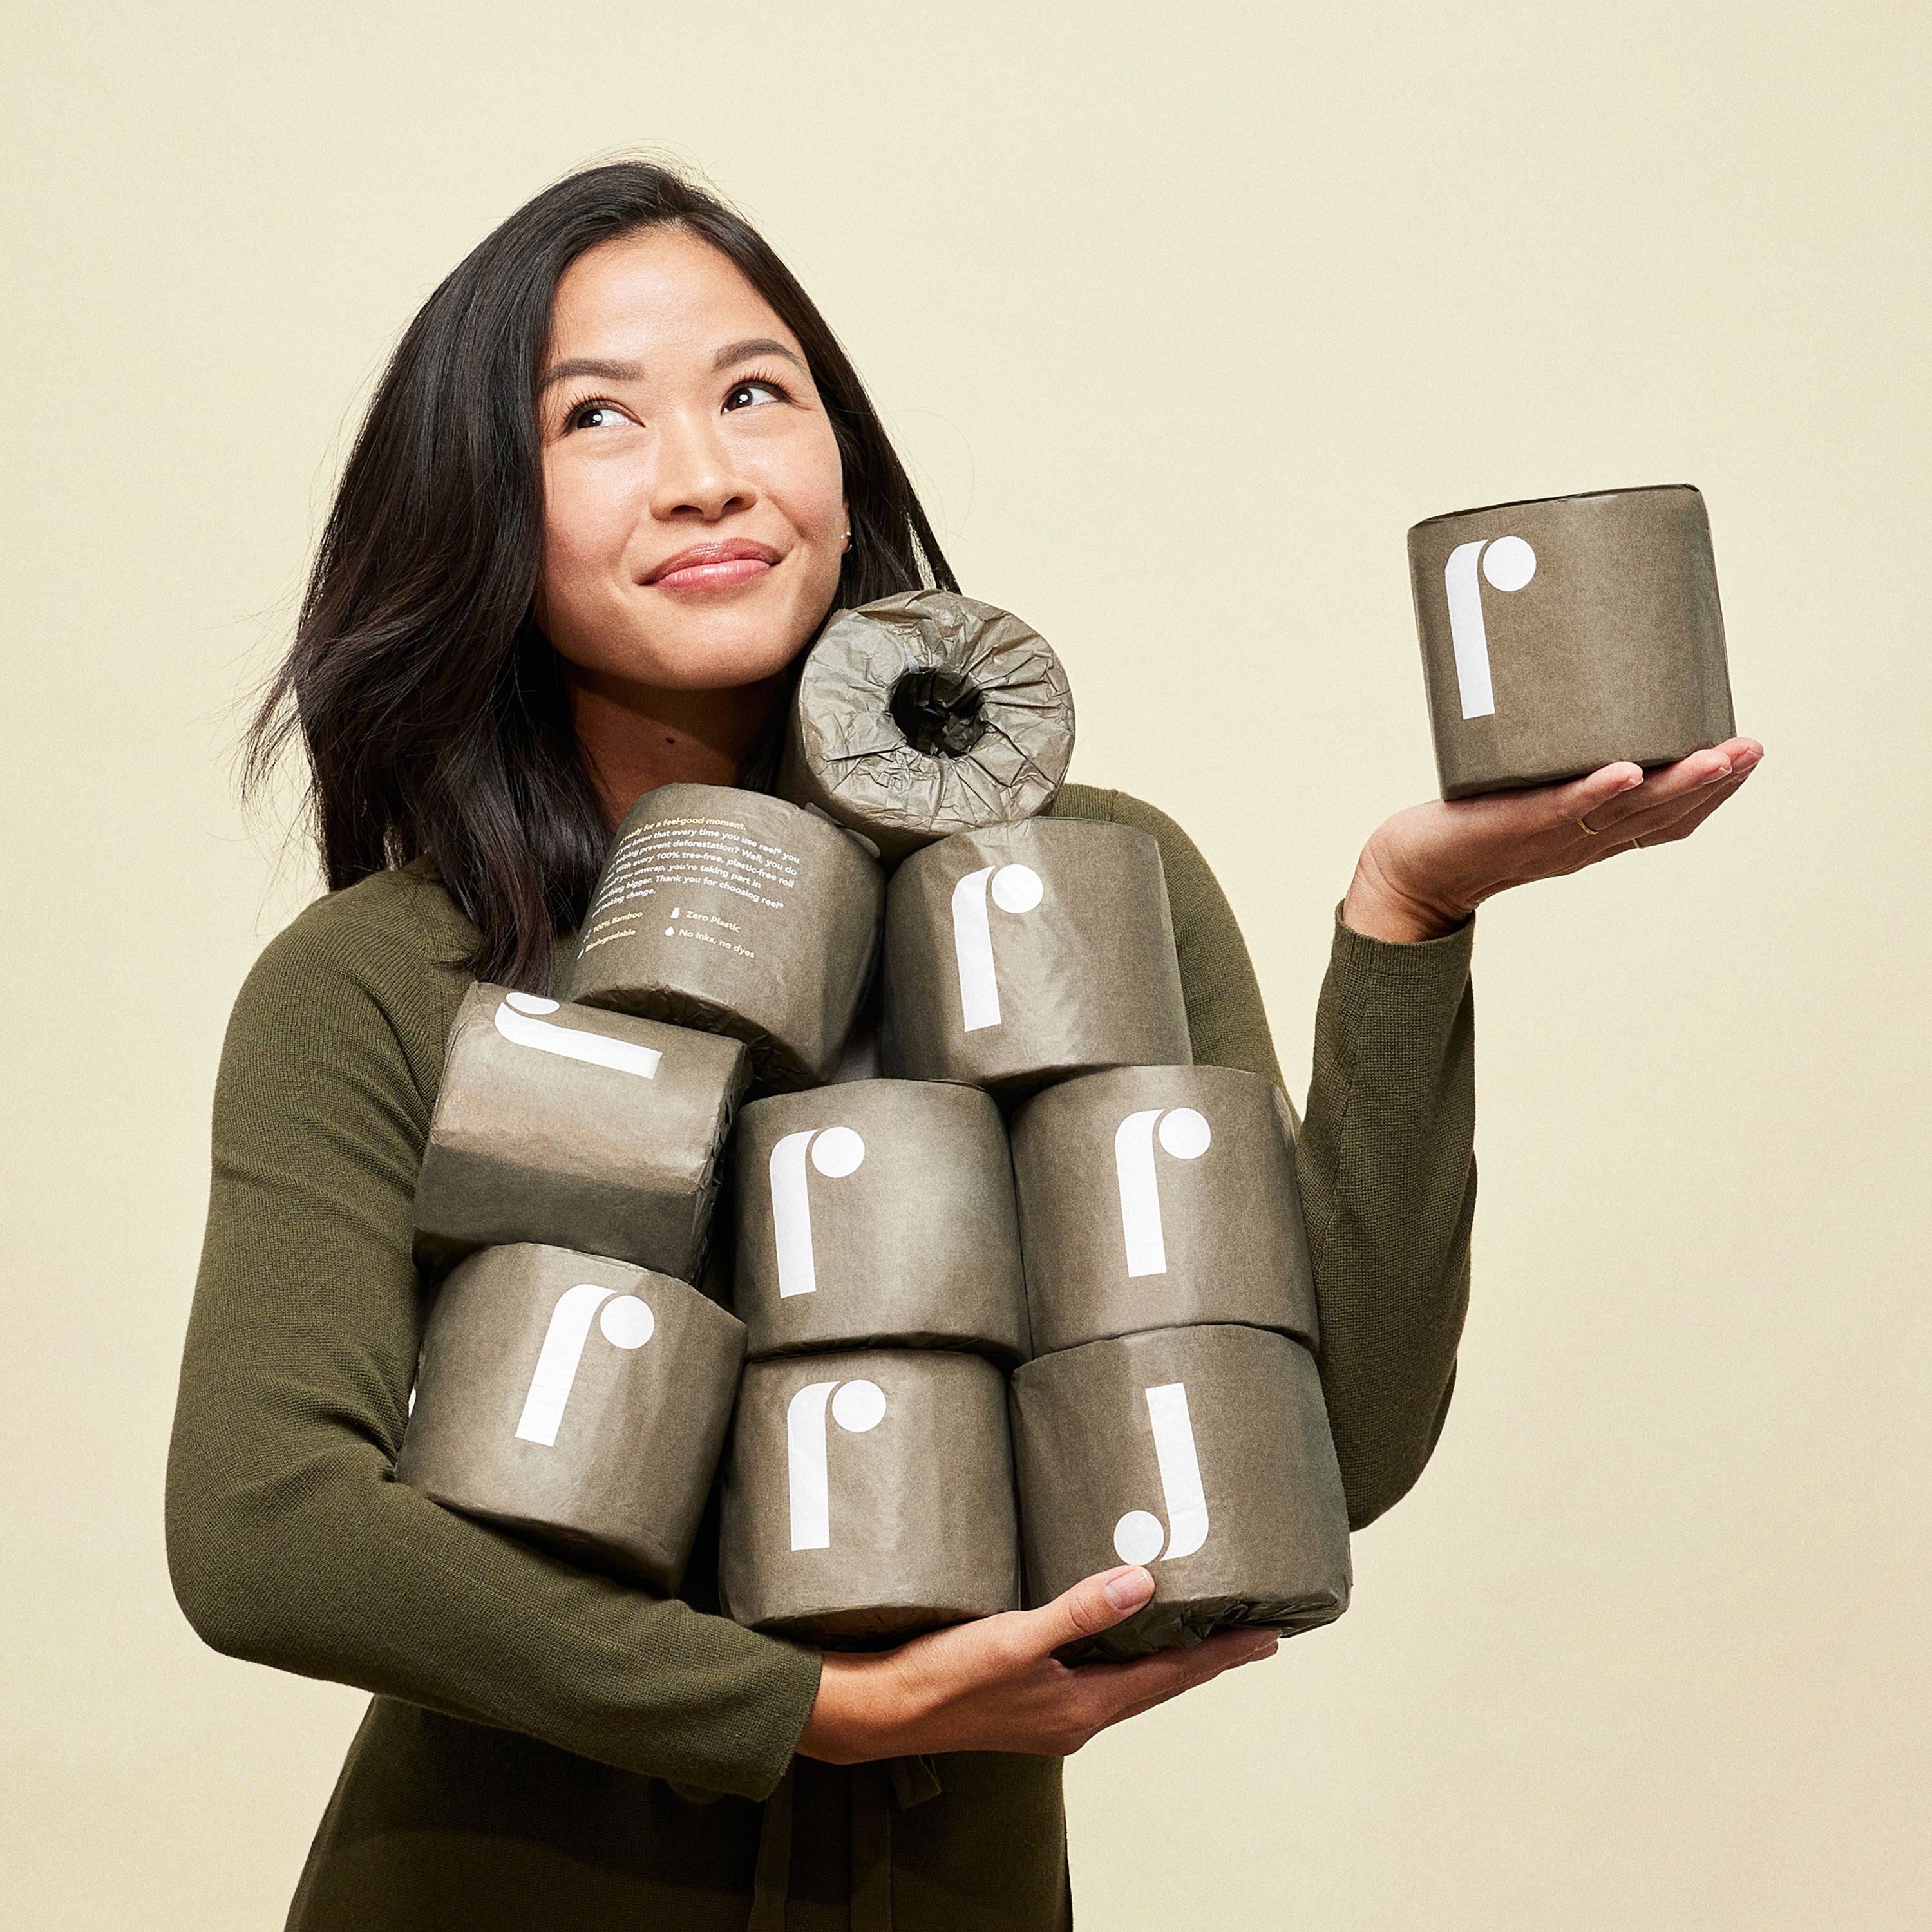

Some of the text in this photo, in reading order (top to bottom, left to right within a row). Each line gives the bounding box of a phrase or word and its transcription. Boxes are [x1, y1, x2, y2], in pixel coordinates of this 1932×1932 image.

[1444, 536, 1537, 720] r
[663, 817, 705, 826] feel-good
[706, 819, 746, 831] moment.
[632, 835, 652, 846] know
[654, 830, 670, 839] that
[699, 828, 720, 837] time
[721, 833, 740, 841] you
[741, 837, 757, 848] use
[782, 852, 800, 864] you
[639, 842, 672, 855] prevent
[672, 839, 740, 854] deforestation?
[741, 848, 763, 864] Well,
[764, 859, 783, 871] you
[784, 866, 797, 876] do
[618, 872, 634, 883] you
[634, 865, 666, 876] unwrap,
[668, 863, 698, 872] you're
[699, 865, 730, 878] taking
[730, 873, 751, 885] part
[752, 879, 761, 889] in
[632, 855, 654, 866] every
[656, 851, 680, 860] 100%
[682, 852, 724, 864] tree-free,
[726, 858, 777, 881] plastic-free
[778, 877, 795, 888] roll
[625, 888, 656, 900] change.
[626, 878, 653, 889] bigger.
[656, 875, 682, 883] Thank
[703, 876, 718, 886] for
[719, 881, 760, 903] choosing
[611, 911, 643, 925] Bamboo
[685, 911, 741, 933] Zero Plastic
[585, 929, 636, 952] Biodegradable
[678, 929, 755, 959] No inks, no dyes
[951, 862, 1044, 1032] r
[1114, 1107, 1211, 1278] r
[768, 1126, 866, 1298] r
[515, 1283, 655, 1448] r
[787, 1379, 887, 1551] r
